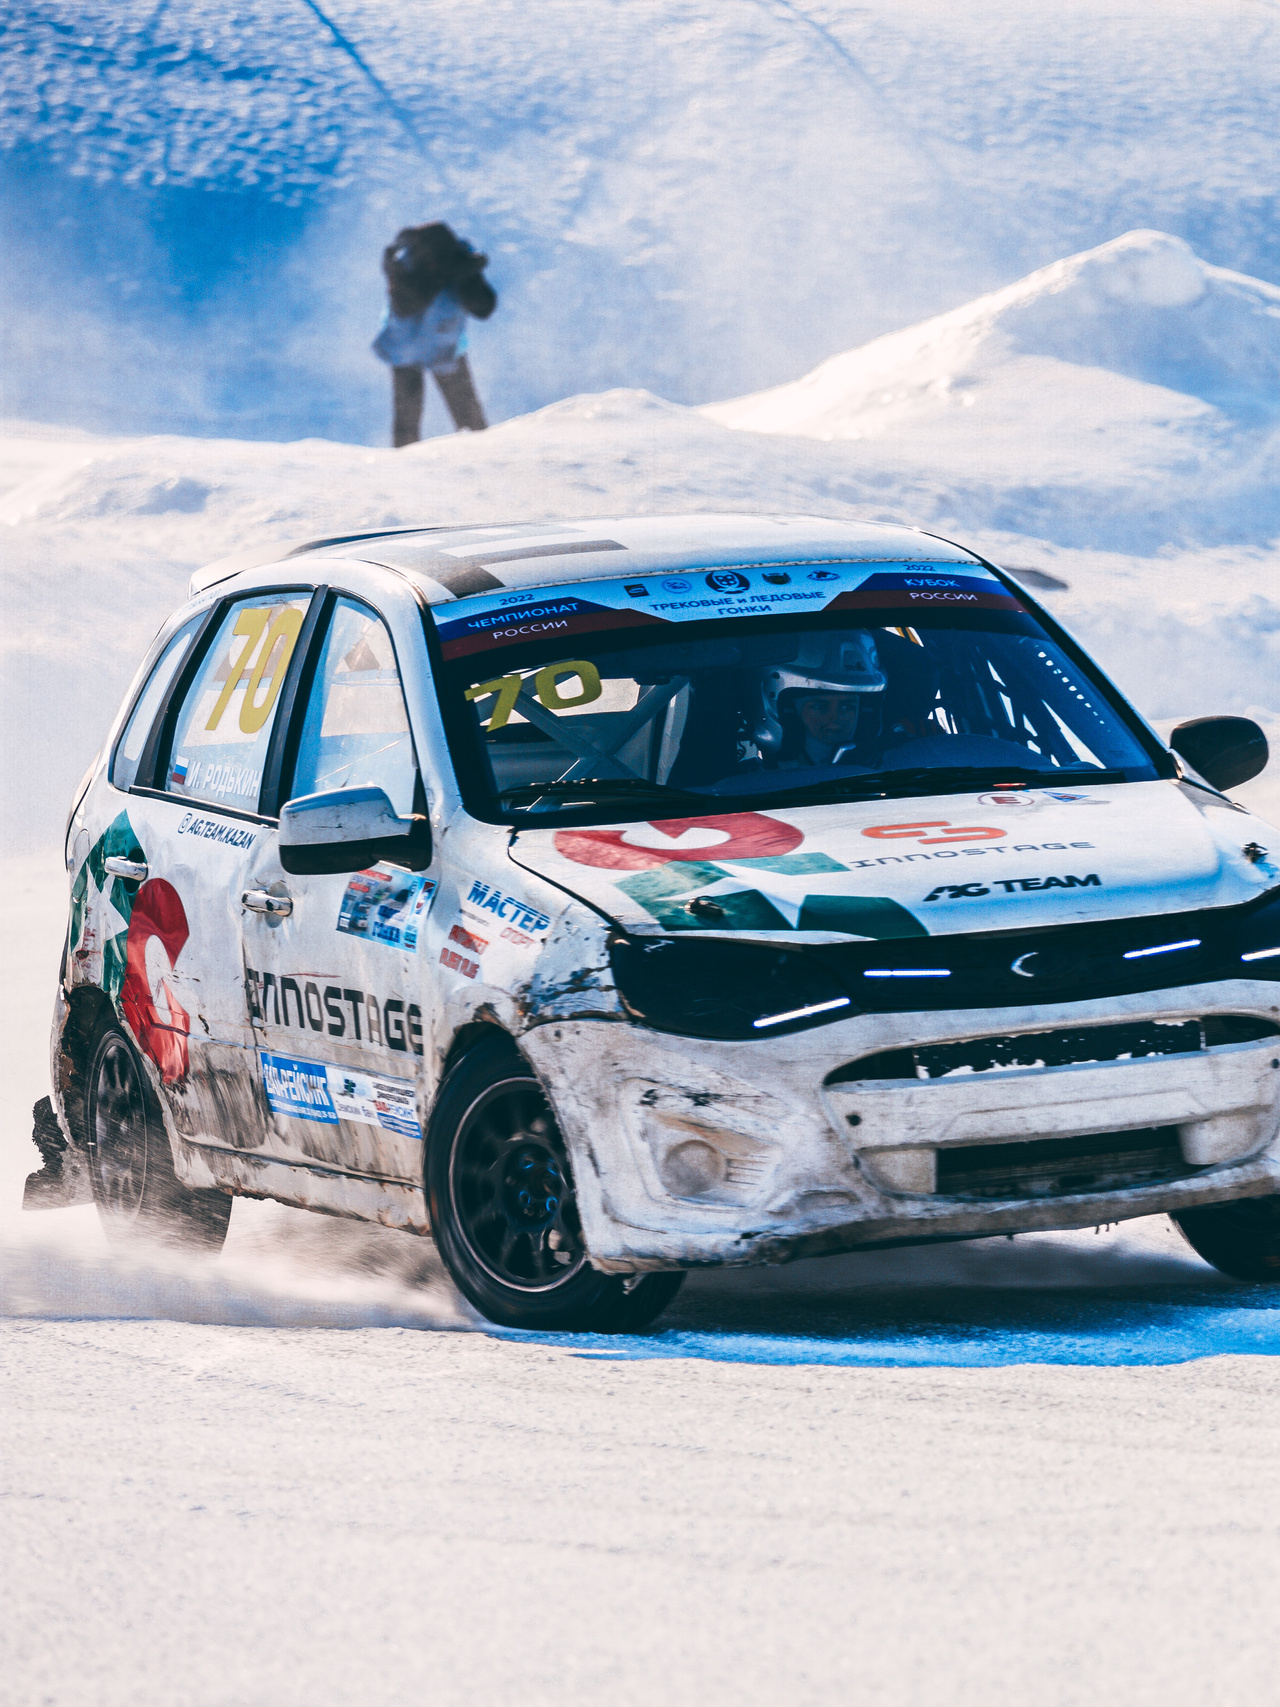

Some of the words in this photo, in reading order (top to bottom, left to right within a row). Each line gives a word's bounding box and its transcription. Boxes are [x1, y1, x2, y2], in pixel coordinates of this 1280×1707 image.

[903, 564, 936, 572] 2022
[903, 578, 961, 588] КУБОК
[500, 593, 535, 606] 2022
[649, 597, 733, 612] ТРЕКОВЫЕ
[750, 590, 827, 603] ЛЕДОВЫЕ
[909, 592, 979, 601] РОССИИ
[467, 602, 579, 630] ЧЕМПИОНАТ
[717, 604, 772, 616] ГОНКИ
[492, 619, 568, 640] РОССИИ
[204, 608, 304, 735] 70
[463, 660, 603, 733] 70
[187, 761, 202, 788] И.
[202, 763, 263, 798] РОДЬКИН
[186, 818, 257, 850] AG.TEAM.KAZAN
[850, 841, 1097, 869] INNOSTAGE
[993, 873, 1103, 894] TEAM
[467, 880, 551, 934] МАСТЕР
